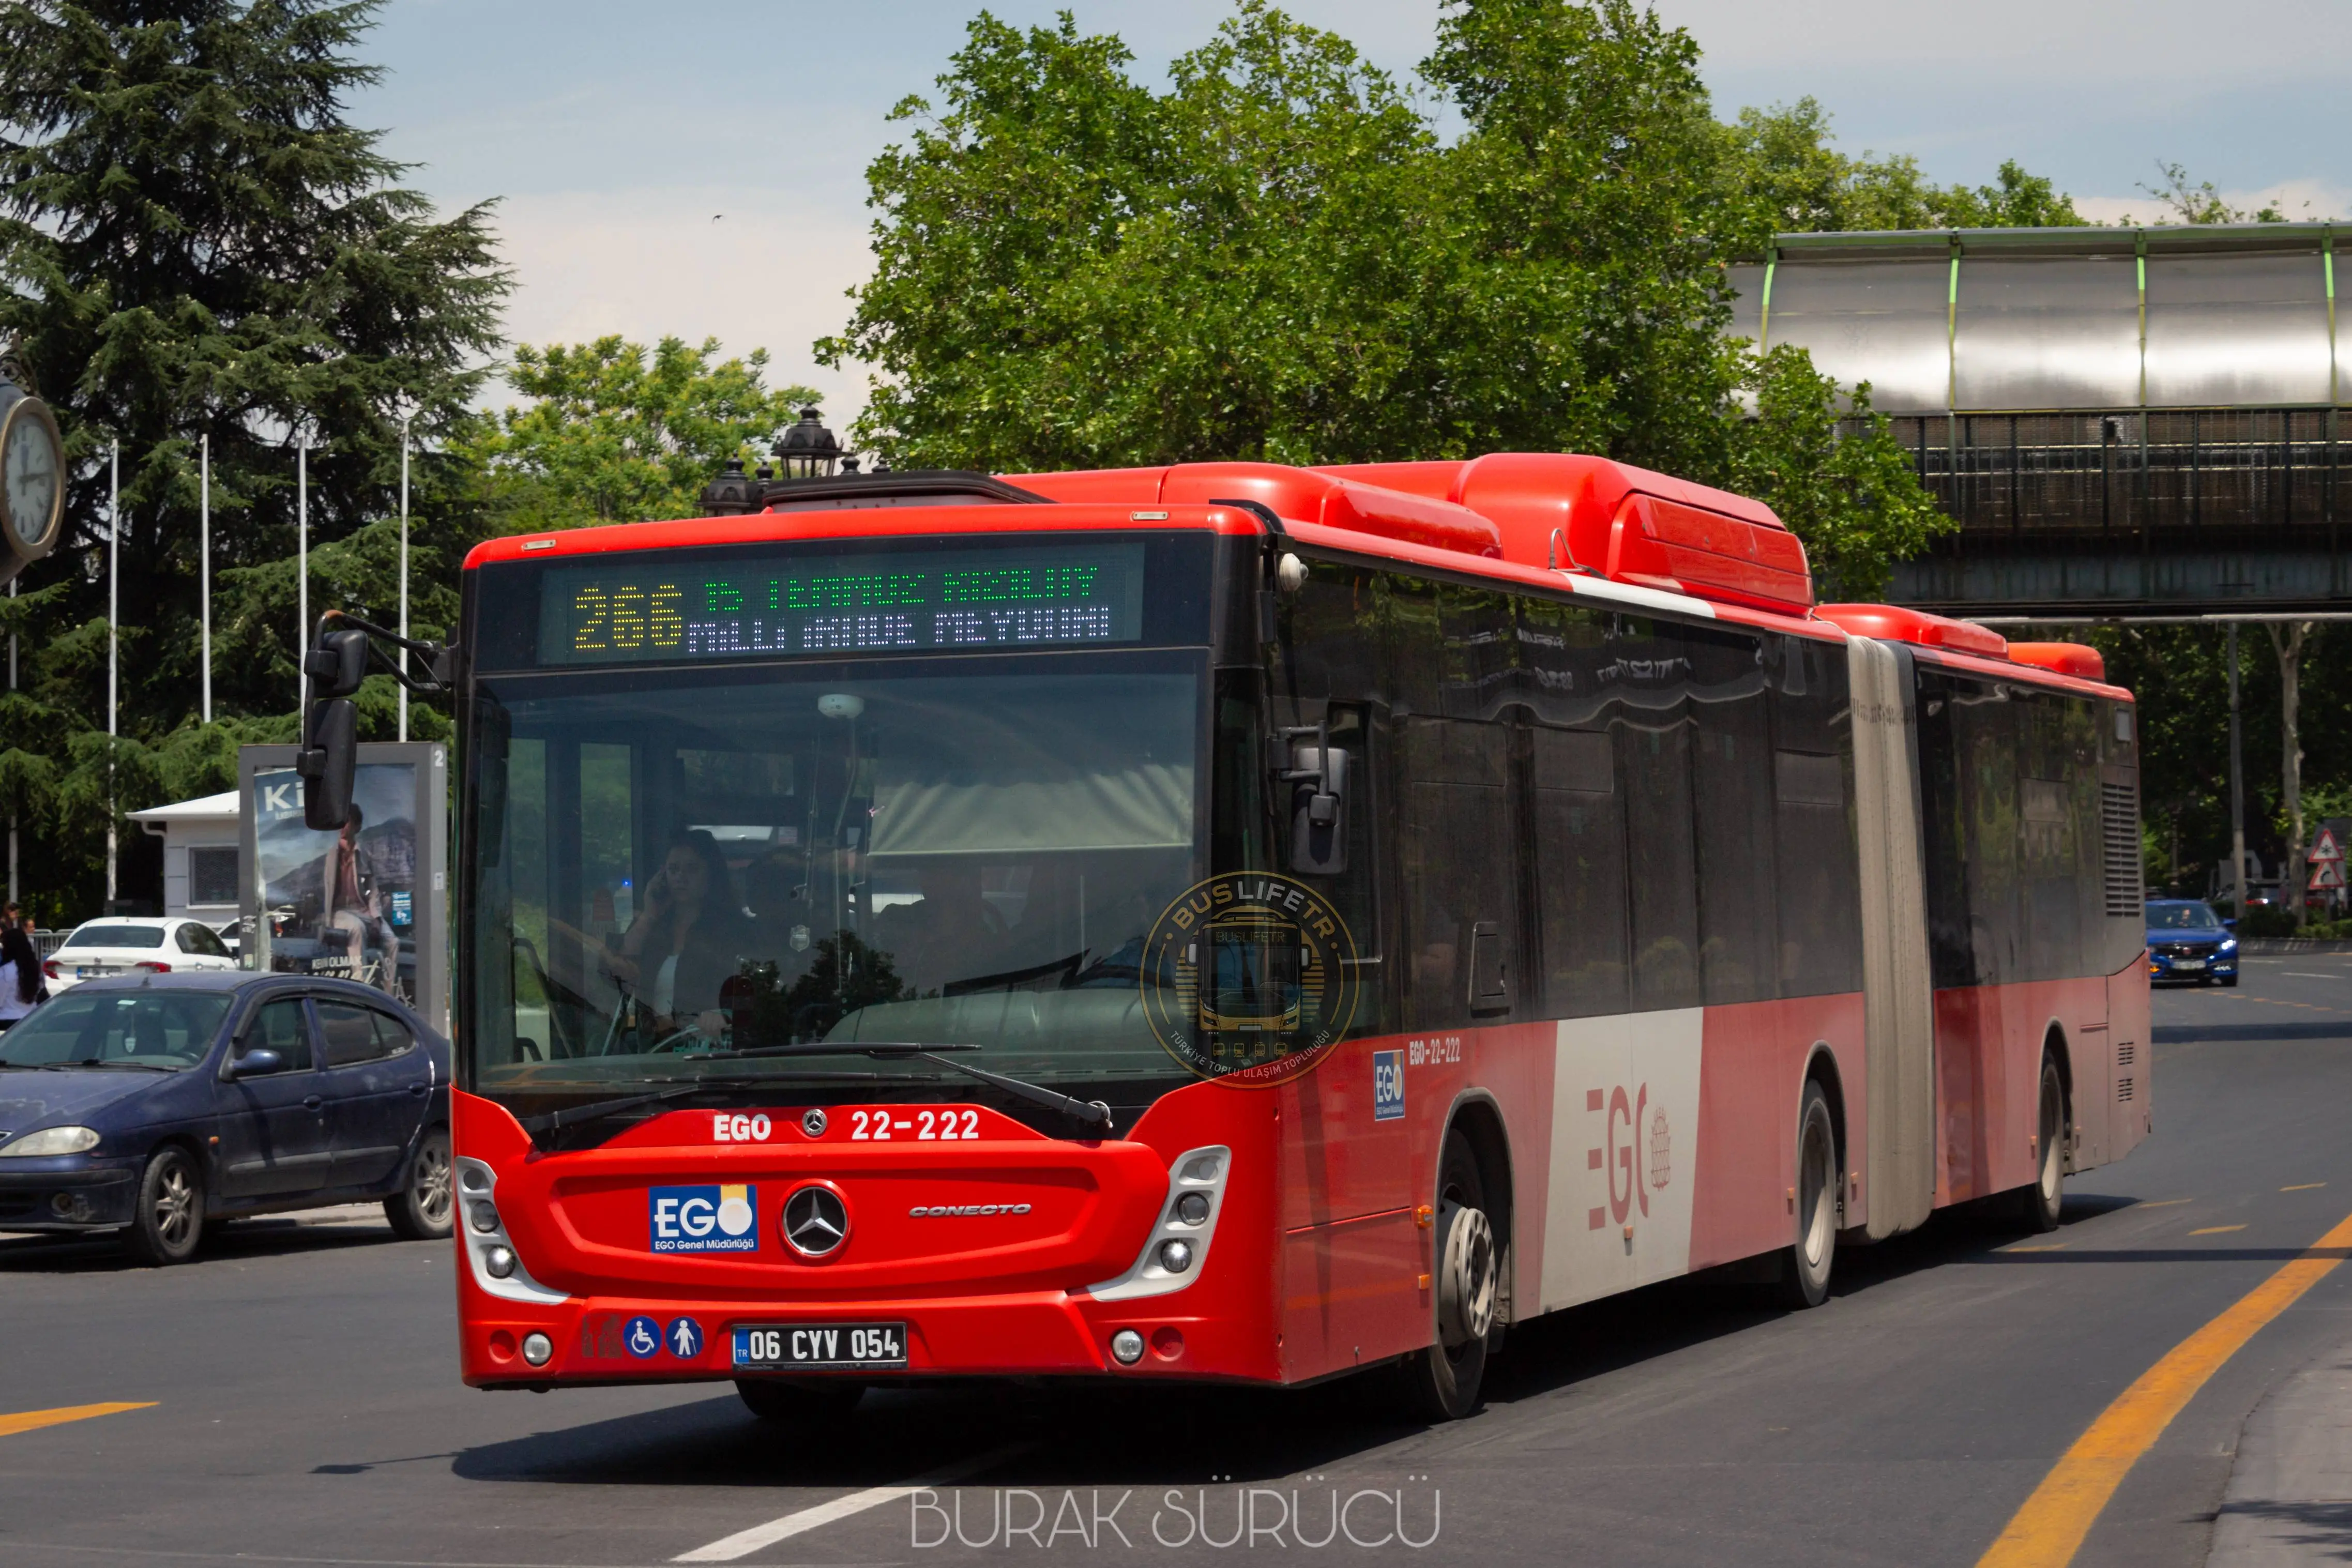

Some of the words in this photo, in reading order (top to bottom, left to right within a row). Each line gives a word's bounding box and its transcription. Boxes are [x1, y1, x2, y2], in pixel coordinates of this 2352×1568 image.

[575, 584, 682, 650] 266
[434, 750, 443, 767] 2
[1409, 1037, 1461, 1065] EGO-22-222
[1375, 1064, 1403, 1103] EGO
[714, 1114, 771, 1141] EGO
[851, 1110, 979, 1140] 22-222
[654, 1196, 753, 1238] EGO
[908, 1203, 1031, 1216] CONECTO
[655, 1241, 675, 1250] EGO
[677, 1240, 705, 1250] Genel
[706, 1239, 754, 1250] Müdürlüğü
[737, 1349, 748, 1358] TR
[750, 1331, 781, 1360] 06
[792, 1329, 839, 1360] CYV
[851, 1329, 900, 1359] 054
